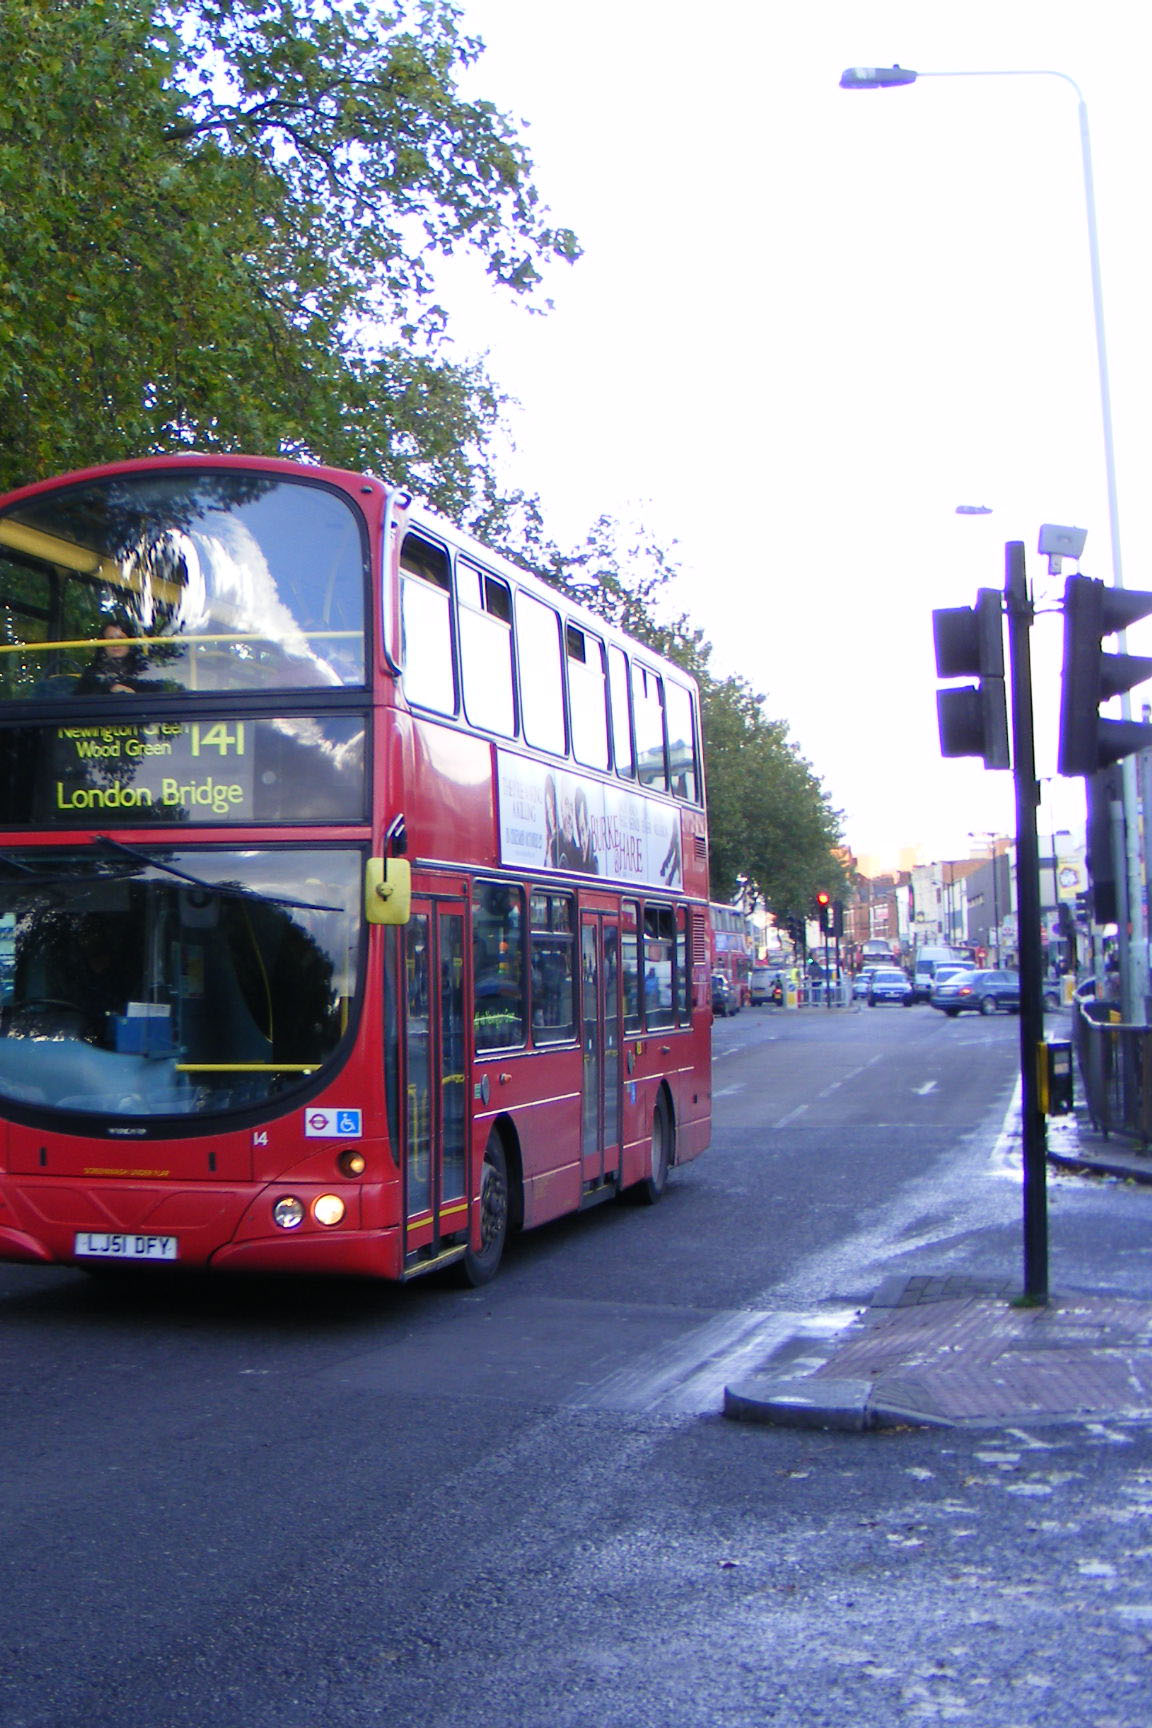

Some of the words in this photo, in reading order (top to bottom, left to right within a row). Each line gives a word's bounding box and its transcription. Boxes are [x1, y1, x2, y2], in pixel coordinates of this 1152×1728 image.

[76, 741, 120, 758] Wood
[125, 739, 172, 756] Green
[191, 722, 245, 756] 141
[57, 781, 152, 809] London
[162, 777, 243, 813] Bridge
[253, 1131, 268, 1146] 14
[88, 1234, 126, 1253] LJ51
[135, 1236, 169, 1255] DFY
